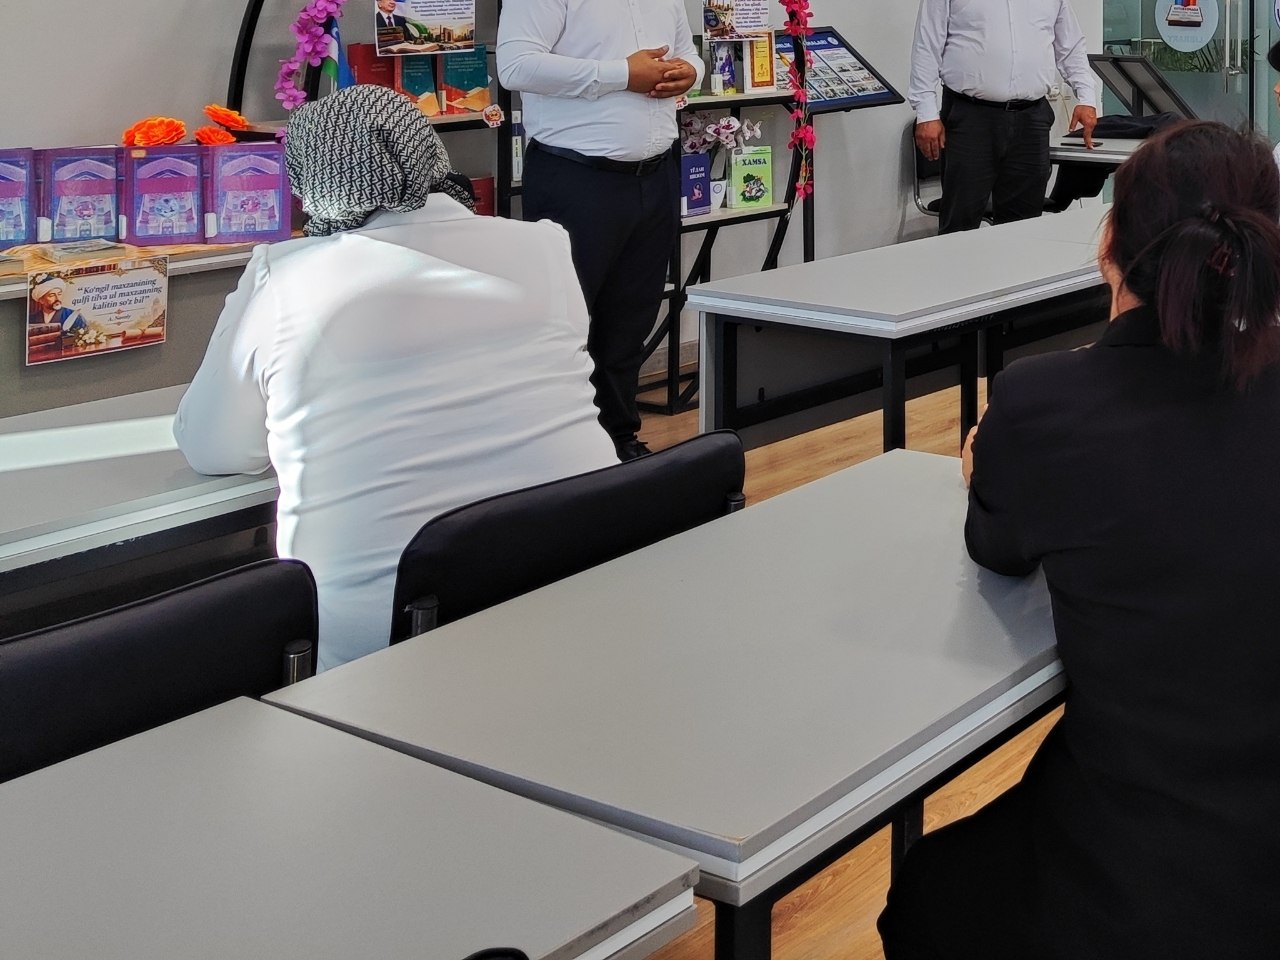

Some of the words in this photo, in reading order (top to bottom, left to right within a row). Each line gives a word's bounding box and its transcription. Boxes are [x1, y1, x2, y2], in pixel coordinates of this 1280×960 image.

[742, 158, 767, 166] XAMSA
[111, 279, 157, 291] maxzanining
[71, 296, 90, 306] qulfi
[109, 291, 117, 299] ul
[118, 286, 162, 298] maxzanning
[92, 301, 118, 310] kalitin
